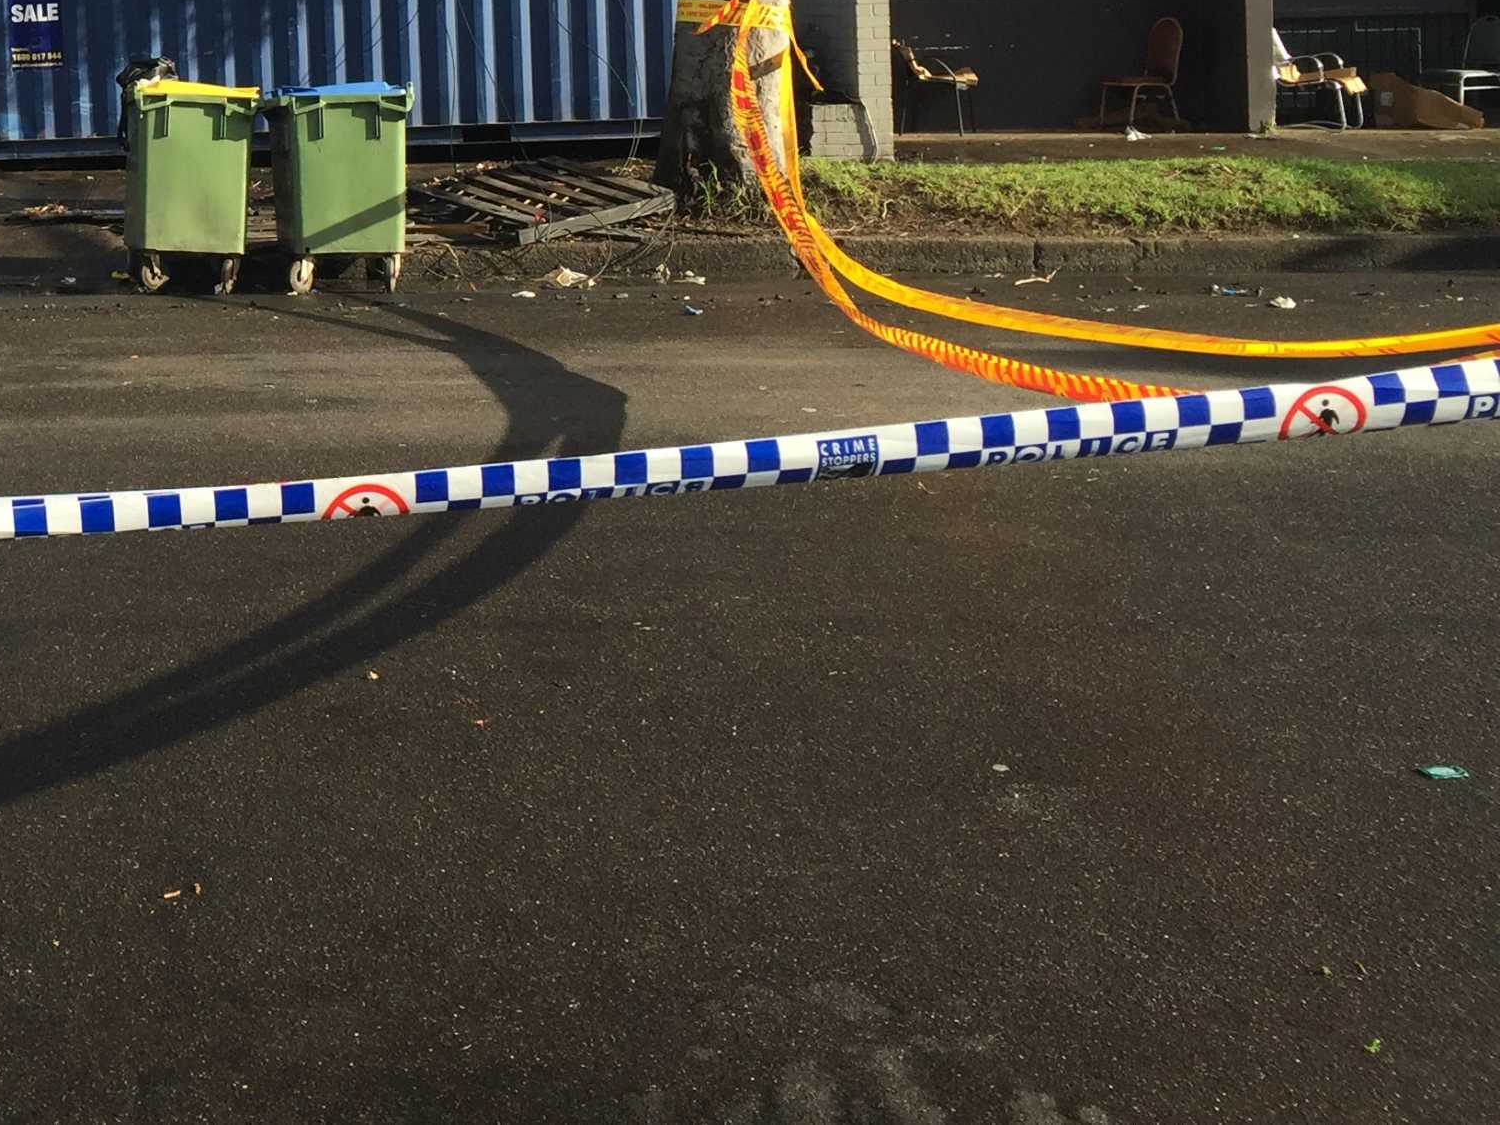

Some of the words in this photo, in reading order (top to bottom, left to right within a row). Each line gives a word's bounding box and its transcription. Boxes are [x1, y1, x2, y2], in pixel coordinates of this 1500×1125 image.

[10, 2, 60, 24] SALE
[820, 437, 876, 456] CRIME
[986, 432, 1170, 465] POLICE
[821, 452, 877, 467] STOPPERS
